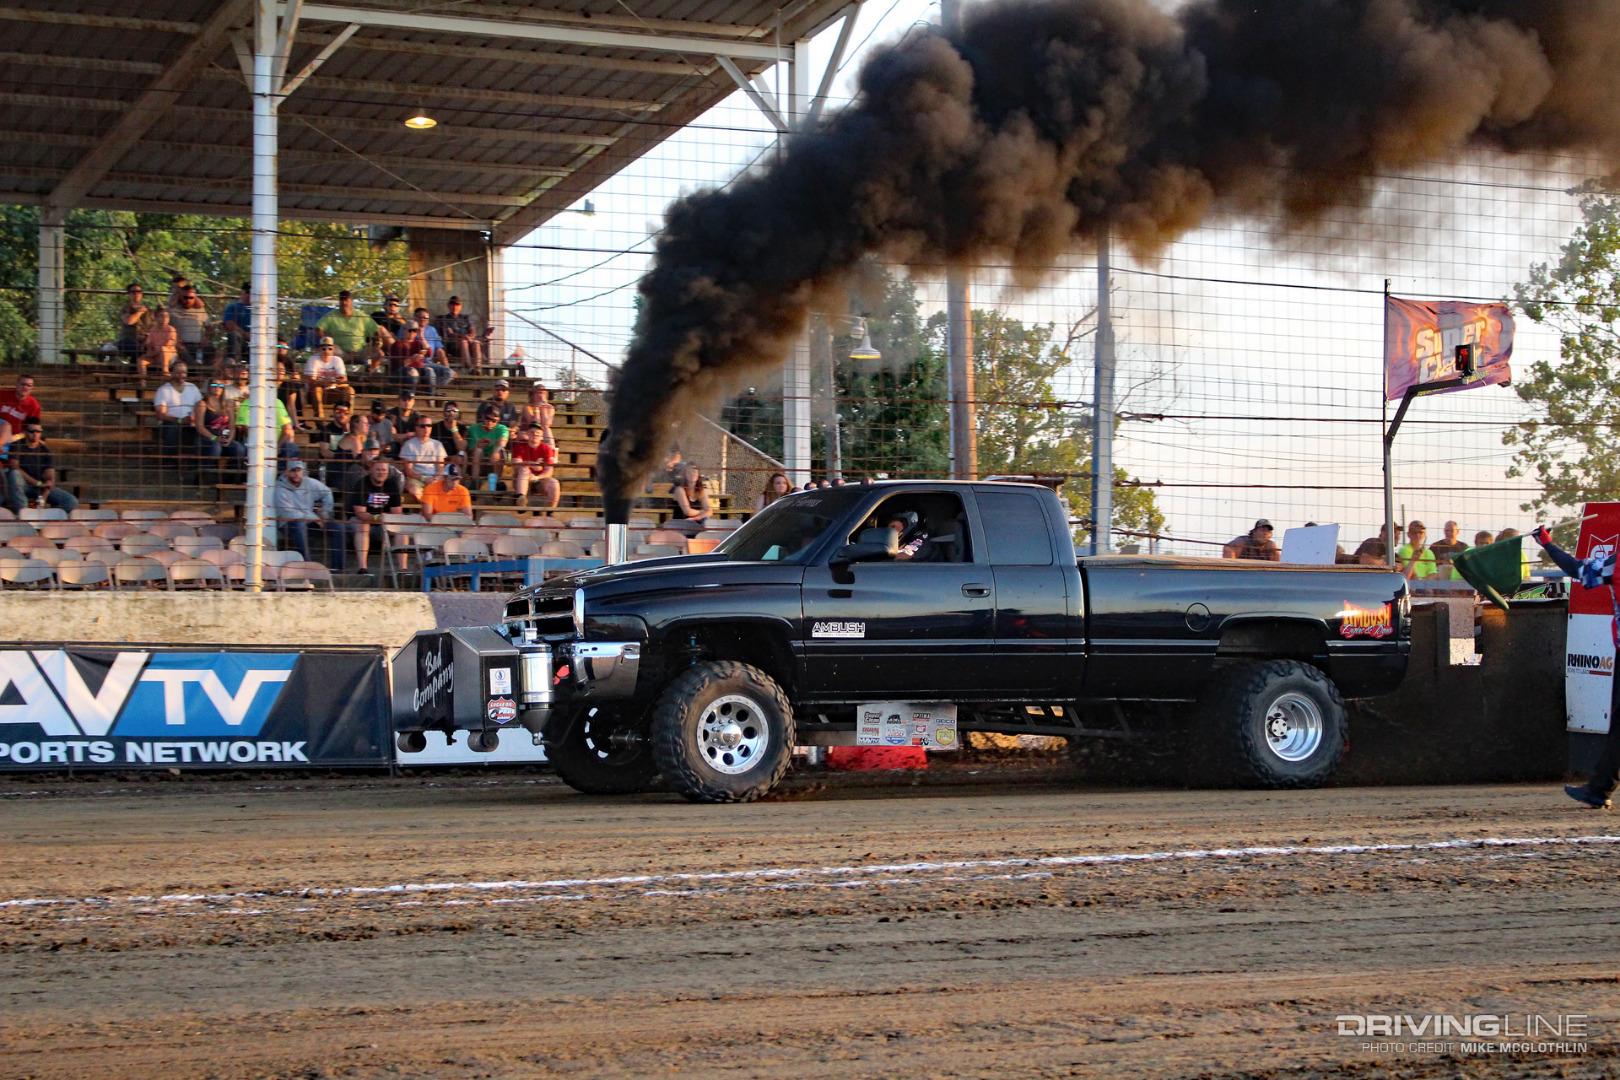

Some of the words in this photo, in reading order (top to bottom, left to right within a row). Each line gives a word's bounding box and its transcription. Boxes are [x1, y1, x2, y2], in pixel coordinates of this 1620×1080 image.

[812, 621, 866, 633] AMBUSH
[1343, 601, 1391, 627] AMBUSH
[425, 637, 443, 677] Bad
[413, 662, 454, 712] Company
[126, 741, 309, 763] NETWORK
